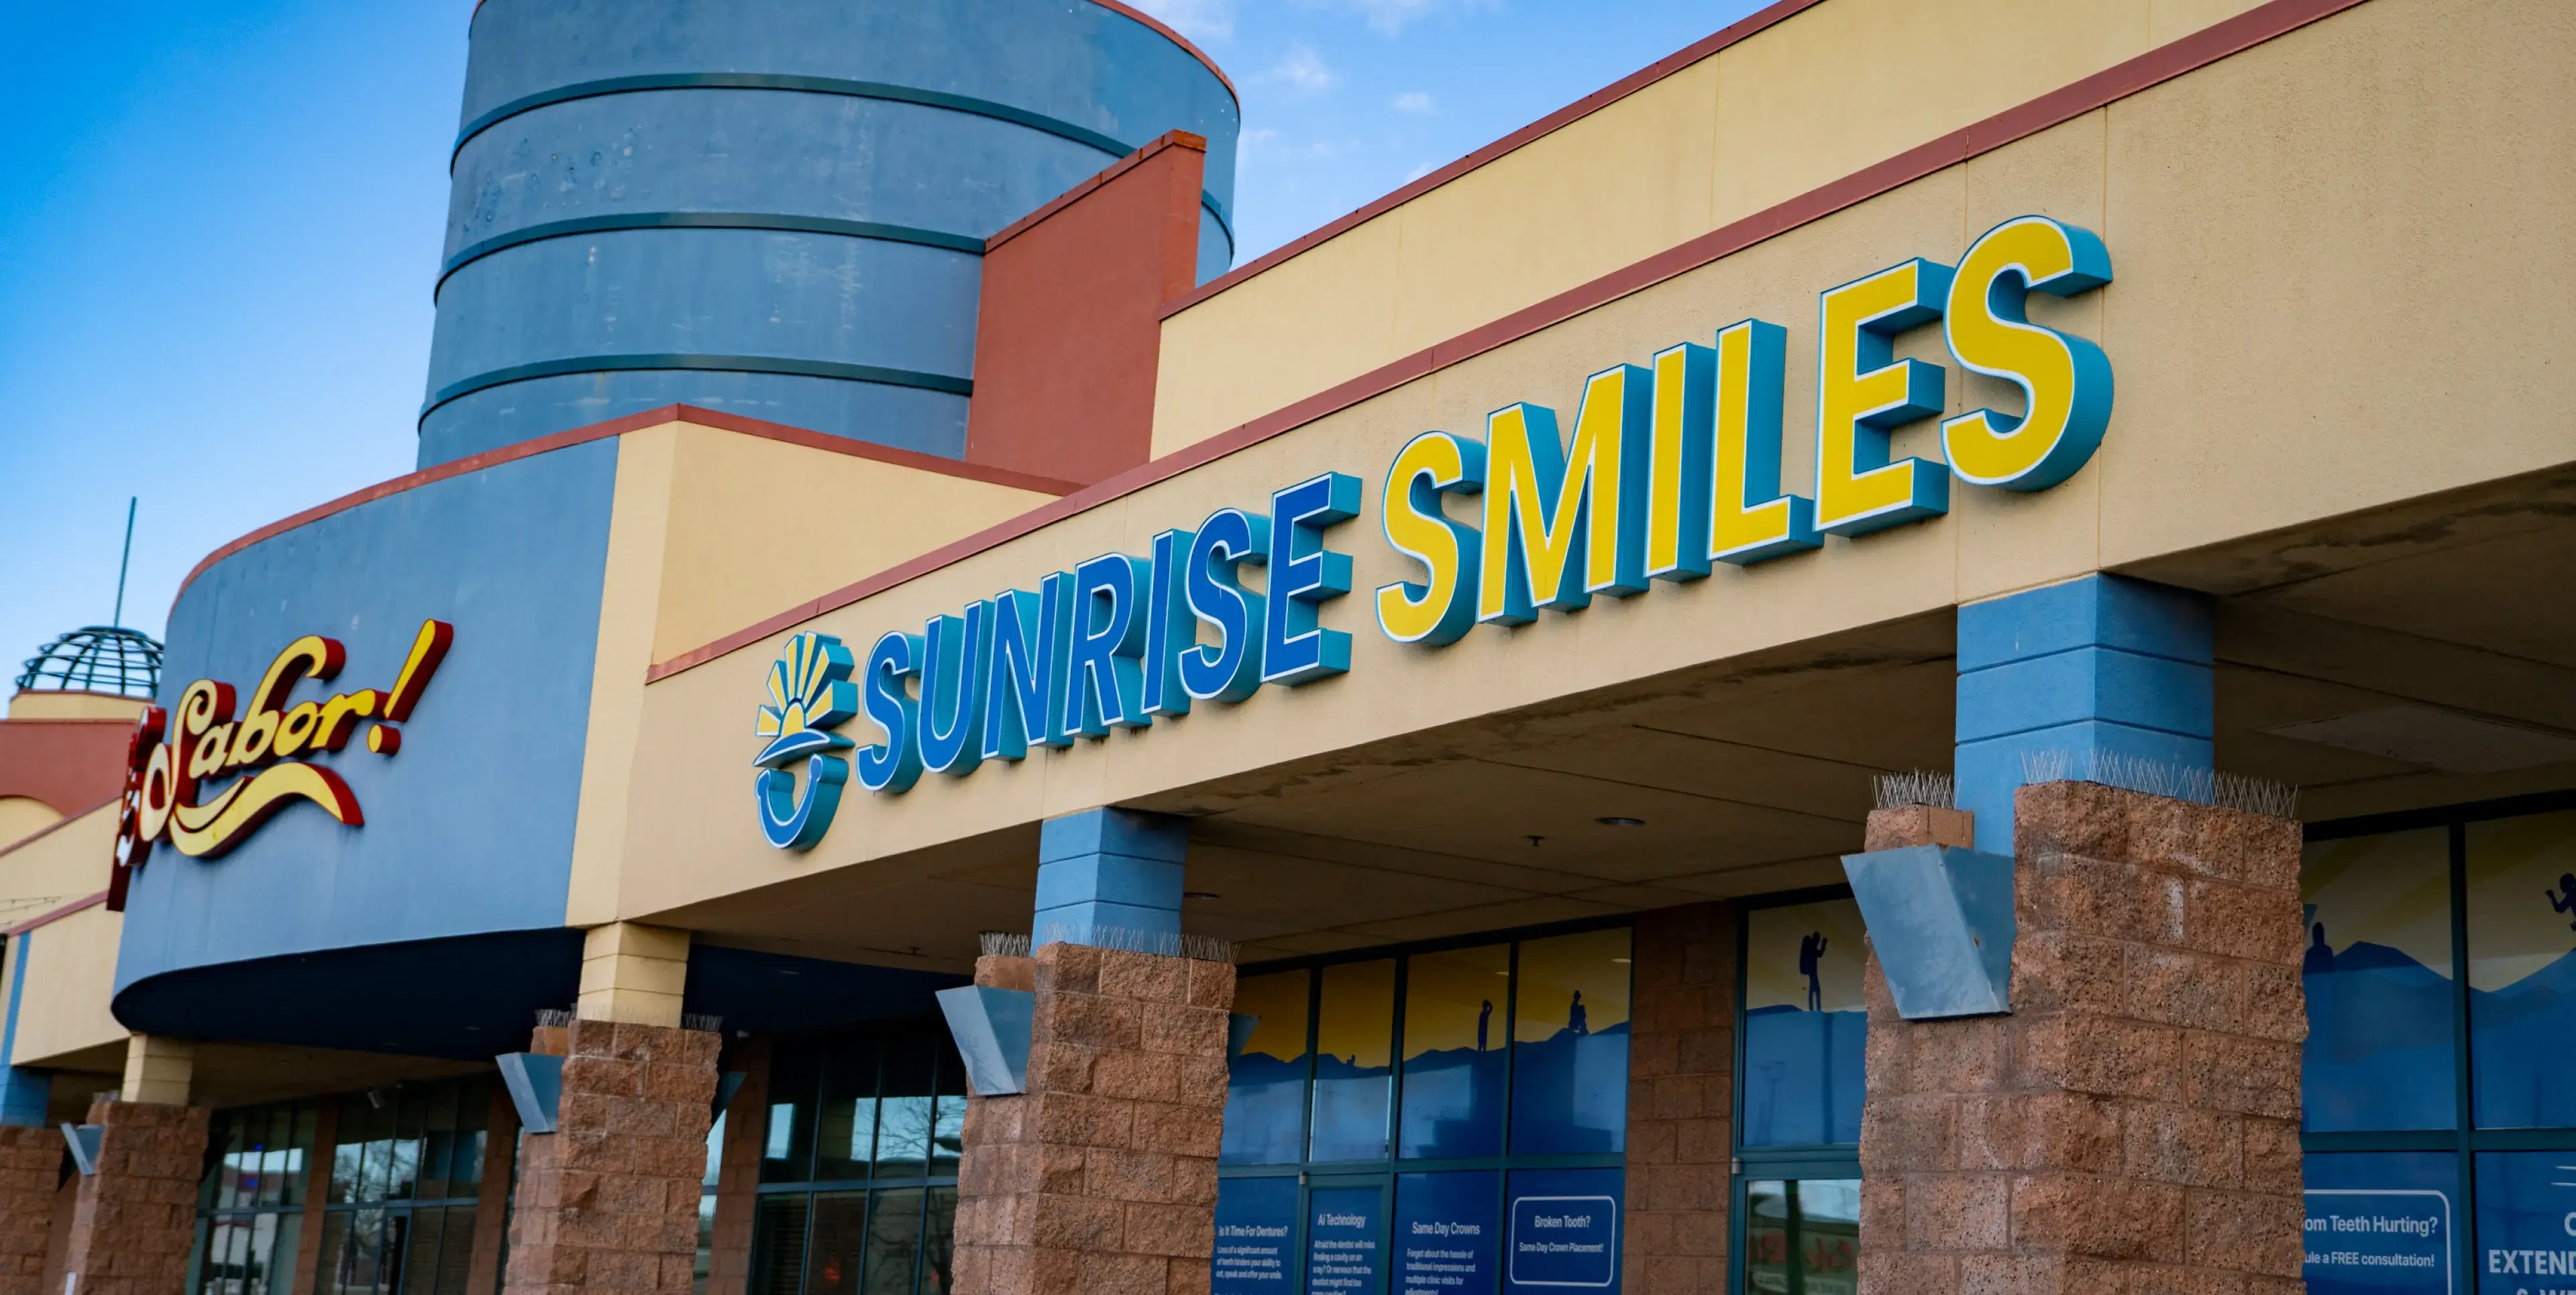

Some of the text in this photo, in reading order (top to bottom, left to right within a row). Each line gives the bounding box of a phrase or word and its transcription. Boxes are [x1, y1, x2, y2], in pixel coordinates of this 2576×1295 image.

[855, 215, 2114, 795] SUNRISE SMILES
[1326, 1213, 1366, 1229] Technology
[1534, 1215, 1591, 1228] Broken Tooth?
[2304, 1215, 2438, 1237] om Teeth Hurting?
[1230, 1225, 1245, 1237] Time
[1246, 1225, 1255, 1237] For
[1256, 1225, 1289, 1237] Dentures?
[1412, 1221, 1481, 1237] Same Day Crowns
[1407, 1248, 1474, 1259] Forget about the hassle of
[1519, 1242, 1604, 1254] Same Day Crown Placement!
[2322, 1255, 2329, 1263] a
[2331, 1251, 2359, 1265] FREE
[2361, 1253, 2434, 1267] consultation!
[1362, 1265, 1372, 1275] the
[1433, 1262, 1464, 1272] impressions
[1465, 1262, 1476, 1272] and
[1427, 1275, 1441, 1284] clinic
[1442, 1276, 1455, 1285] visits
[1456, 1276, 1464, 1285] for
